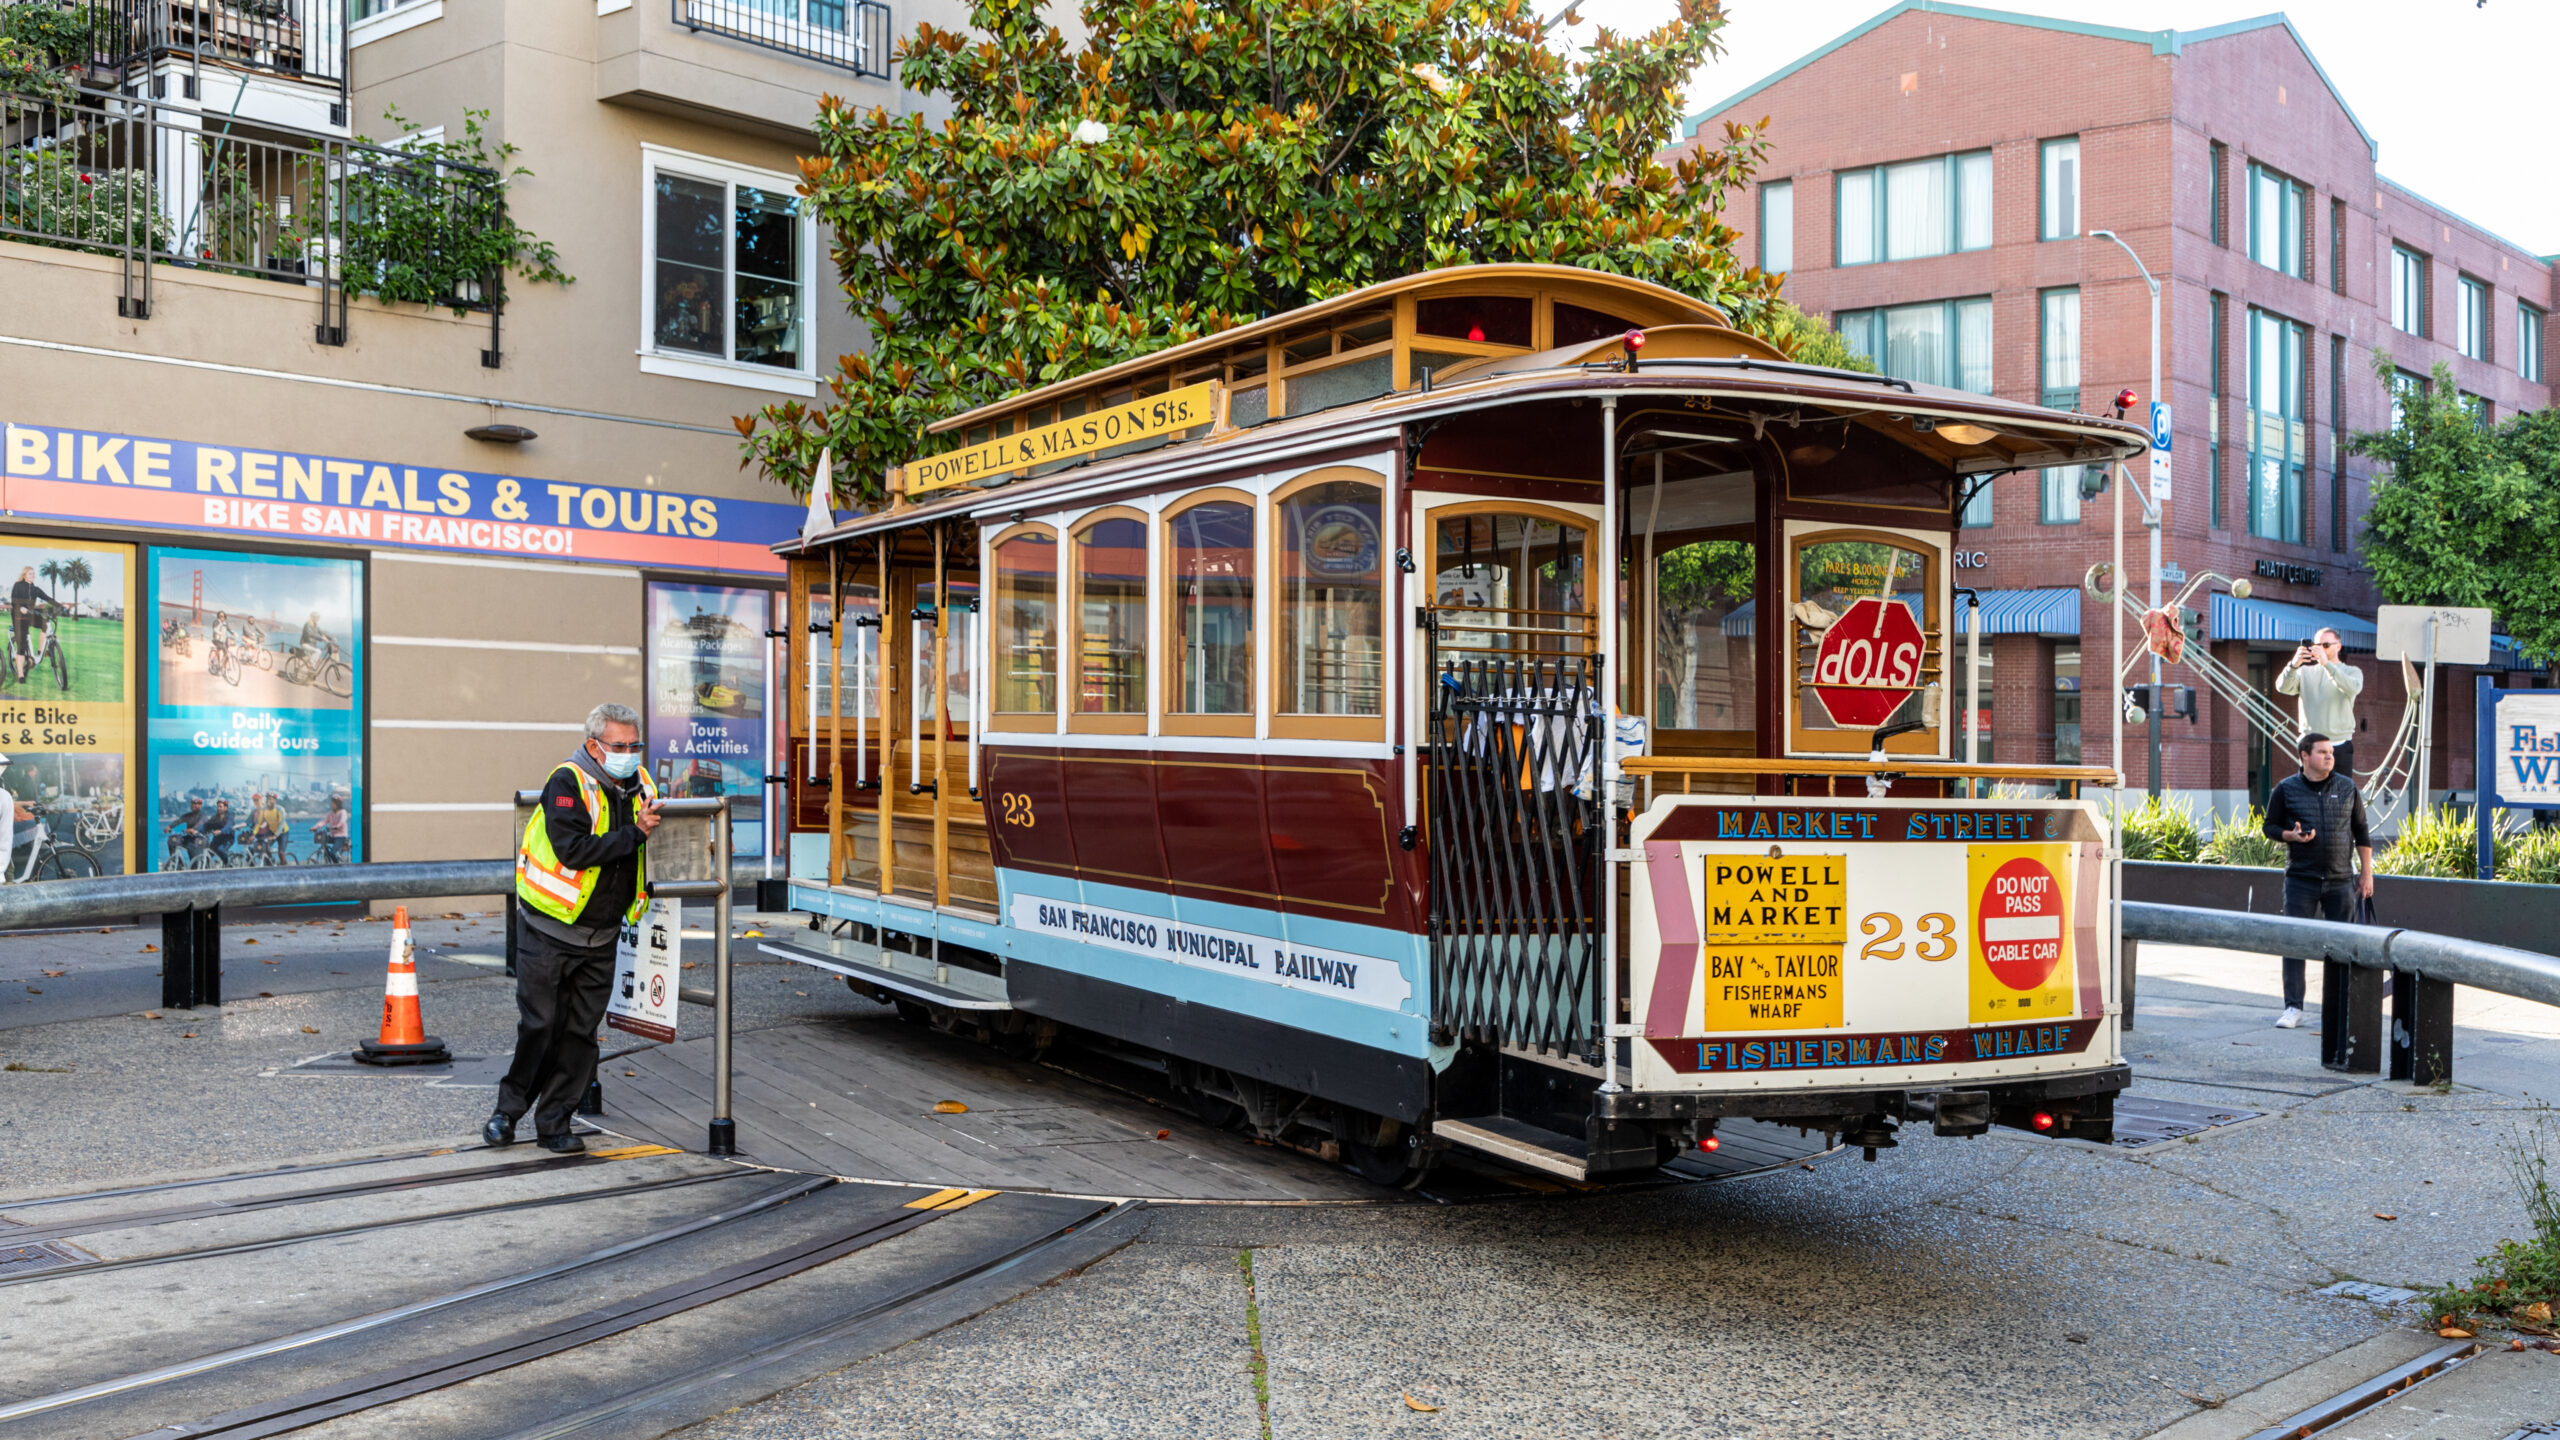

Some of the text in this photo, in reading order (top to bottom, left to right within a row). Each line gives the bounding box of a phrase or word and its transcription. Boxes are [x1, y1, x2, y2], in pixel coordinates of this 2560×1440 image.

[918, 399, 1194, 486] POWELL & MASON Sts.
[6, 427, 719, 538] BIKE RENTALS & TOURS
[204, 497, 573, 554] BIKE SAN FRANCISCO!
[2259, 560, 2286, 579] HYATT
[660, 638, 744, 653] Alcatraz Packages
[1820, 638, 1917, 687] STOP
[34, 707, 78, 724] Bike
[232, 711, 283, 733] Daily
[19, 728, 34, 745] &
[43, 728, 97, 745] Sales
[689, 722, 728, 737] Tours
[193, 731, 320, 750] Guided Tours
[668, 739, 749, 754] & Activities
[2521, 785, 2547, 793] SAN
[1001, 792, 1036, 828] 23
[1717, 810, 1879, 839] MARKET
[1906, 812, 2033, 840] STREET
[1716, 865, 1840, 885] POWELL
[1996, 876, 2050, 894] DO NOT
[1749, 888, 1809, 902] AND
[2005, 895, 2041, 913] PASS
[1713, 906, 1842, 925] MARKET
[1859, 911, 1958, 962] 23
[1039, 904, 1067, 929] SAN
[1072, 909, 1158, 948] FRANCISCO
[1274, 949, 1358, 989] RAILWAY
[1988, 942, 2058, 962] CABLE CAR
[1711, 955, 1839, 978] BAY AND TAYLOR
[1723, 984, 1828, 1001] FISHERMANS
[1749, 1003, 1803, 1019] WHARF
[1697, 1025, 2071, 1071] FISHERMANS WHARF
